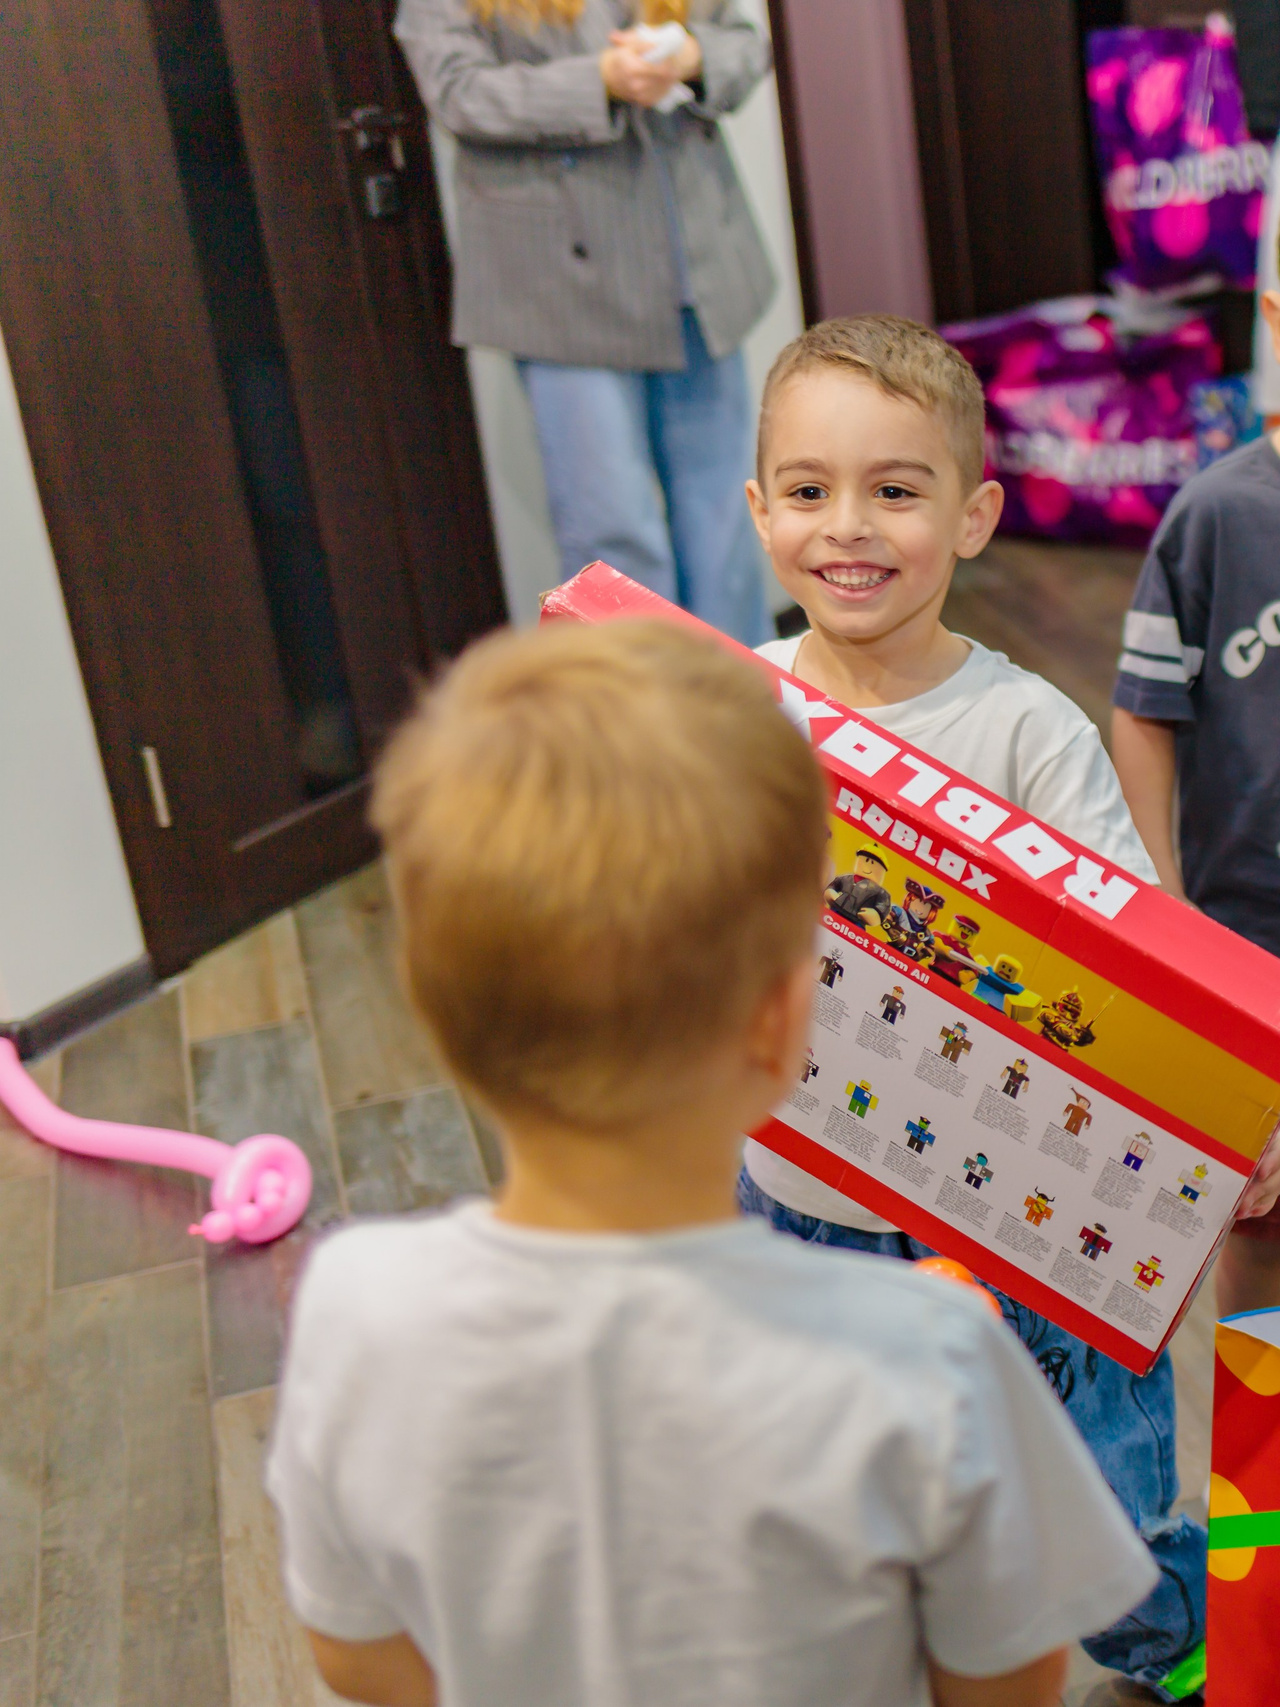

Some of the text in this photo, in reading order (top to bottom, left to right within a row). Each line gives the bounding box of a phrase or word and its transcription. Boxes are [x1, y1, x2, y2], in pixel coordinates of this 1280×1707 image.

[777, 678, 1140, 921] ROBLOX
[835, 787, 998, 901] ROBLOX
[823, 914, 931, 985] Collect Them All
